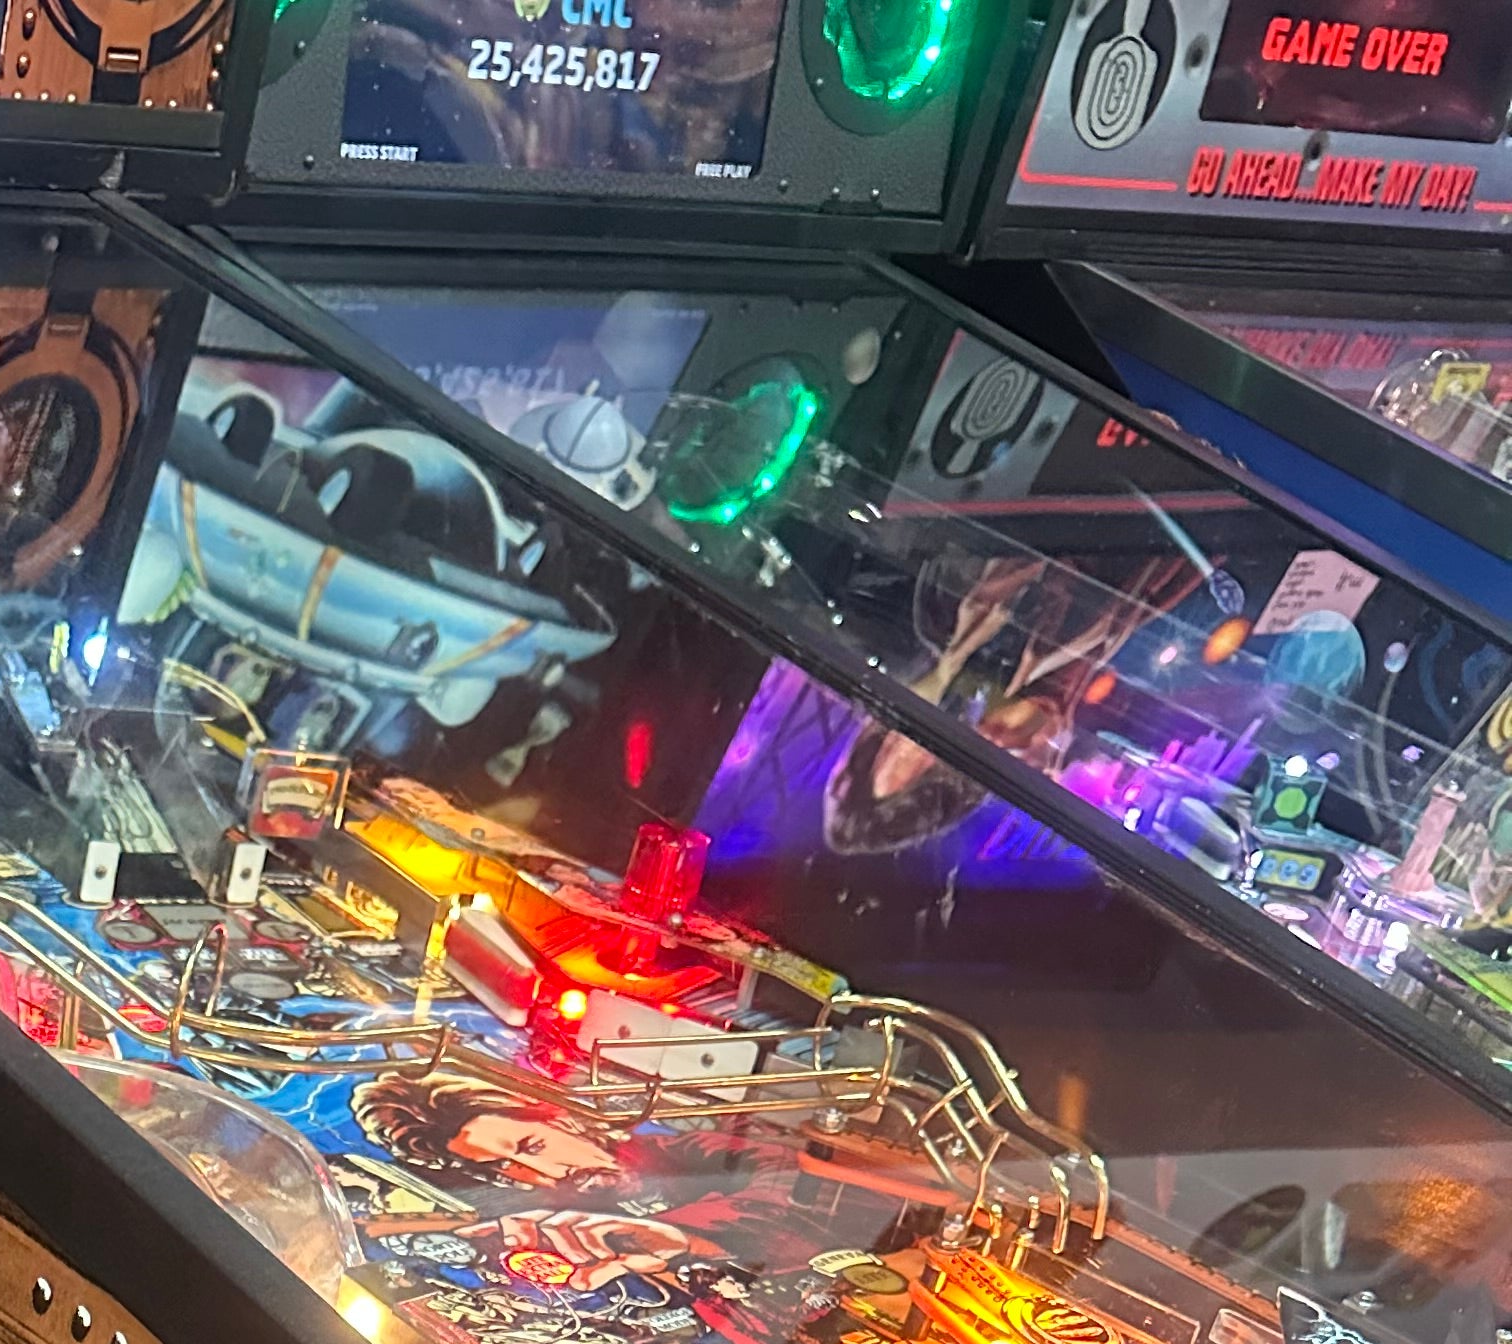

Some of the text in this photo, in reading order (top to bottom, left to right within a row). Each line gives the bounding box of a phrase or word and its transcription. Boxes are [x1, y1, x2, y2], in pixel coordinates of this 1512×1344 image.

[468, 39, 660, 92] 25,425,817
[1261, 16, 1449, 77] GAME OVER
[340, 141, 419, 162] PRESS START
[694, 162, 753, 179] FREE PLAY
[1188, 146, 1226, 196] GO
[1382, 159, 1426, 209] MY
[1421, 164, 1479, 212] DAY!
